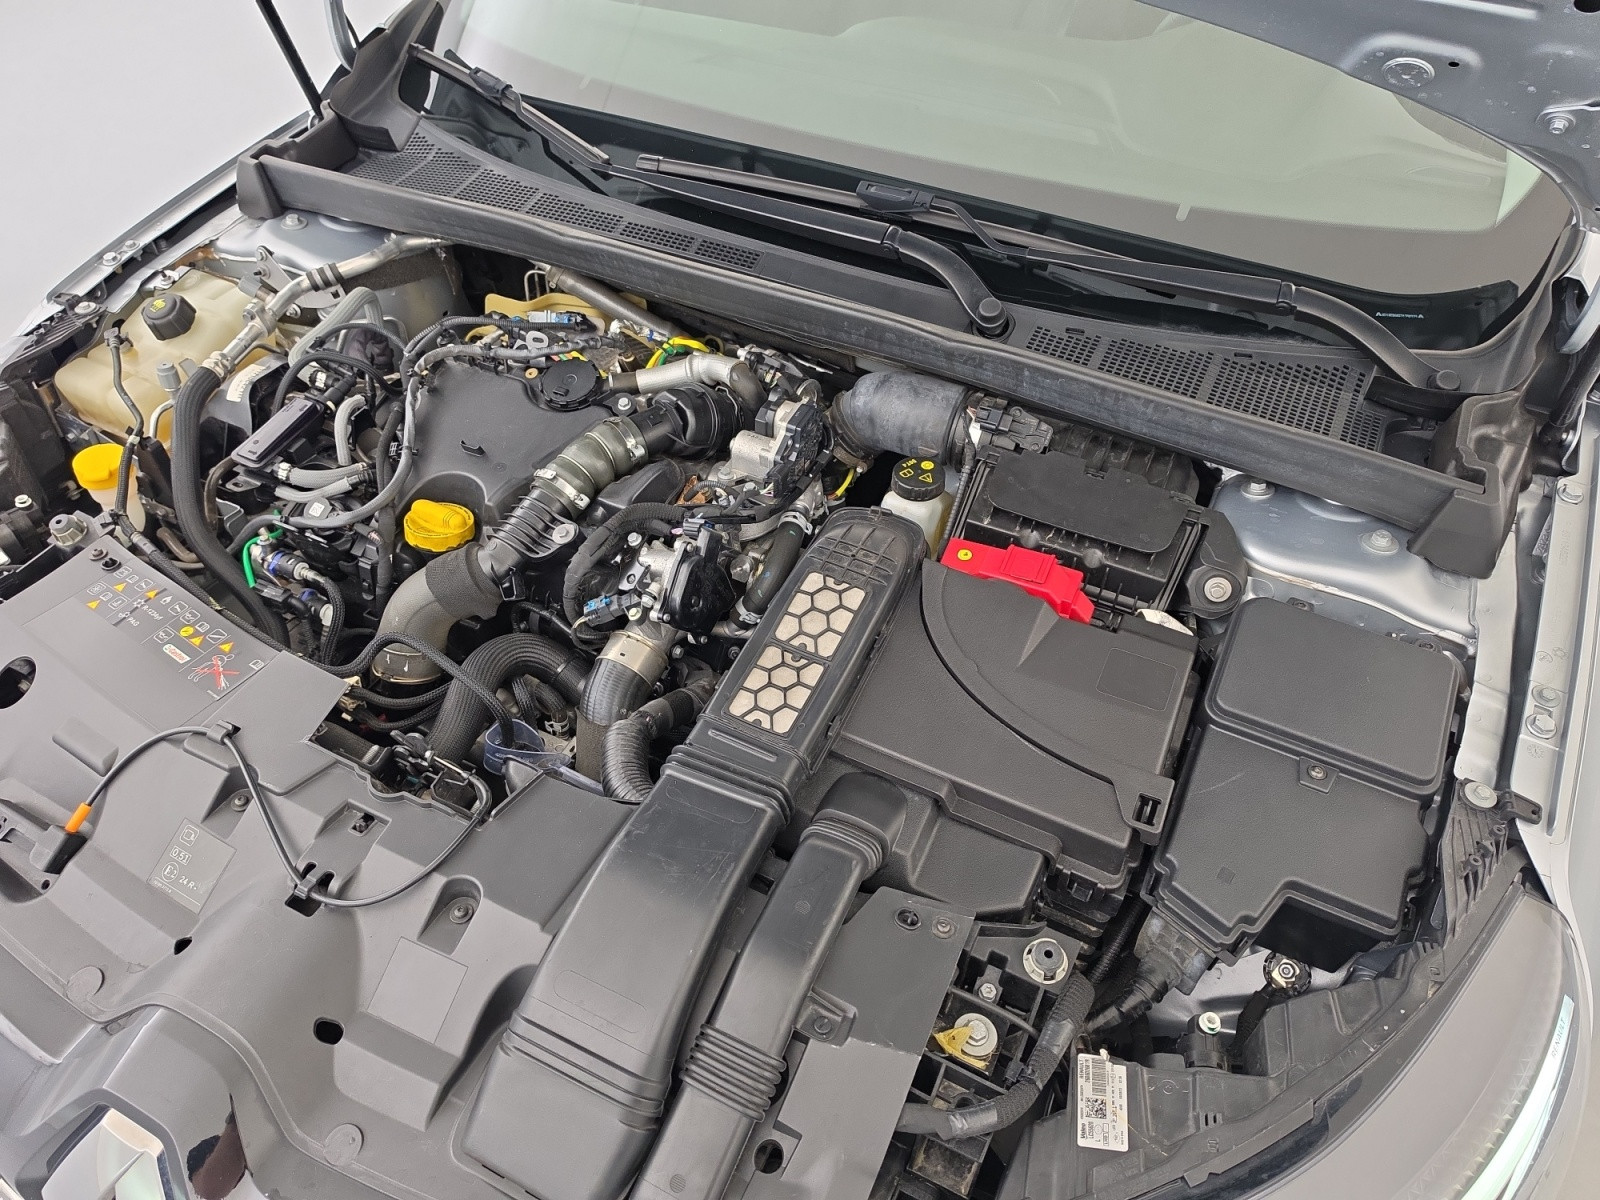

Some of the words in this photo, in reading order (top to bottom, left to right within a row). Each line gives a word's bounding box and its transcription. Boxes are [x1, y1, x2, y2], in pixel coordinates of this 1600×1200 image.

[127, 616, 140, 627] PAG
[179, 875, 189, 885] 24
[1551, 1017, 1566, 1058] RENAULT
